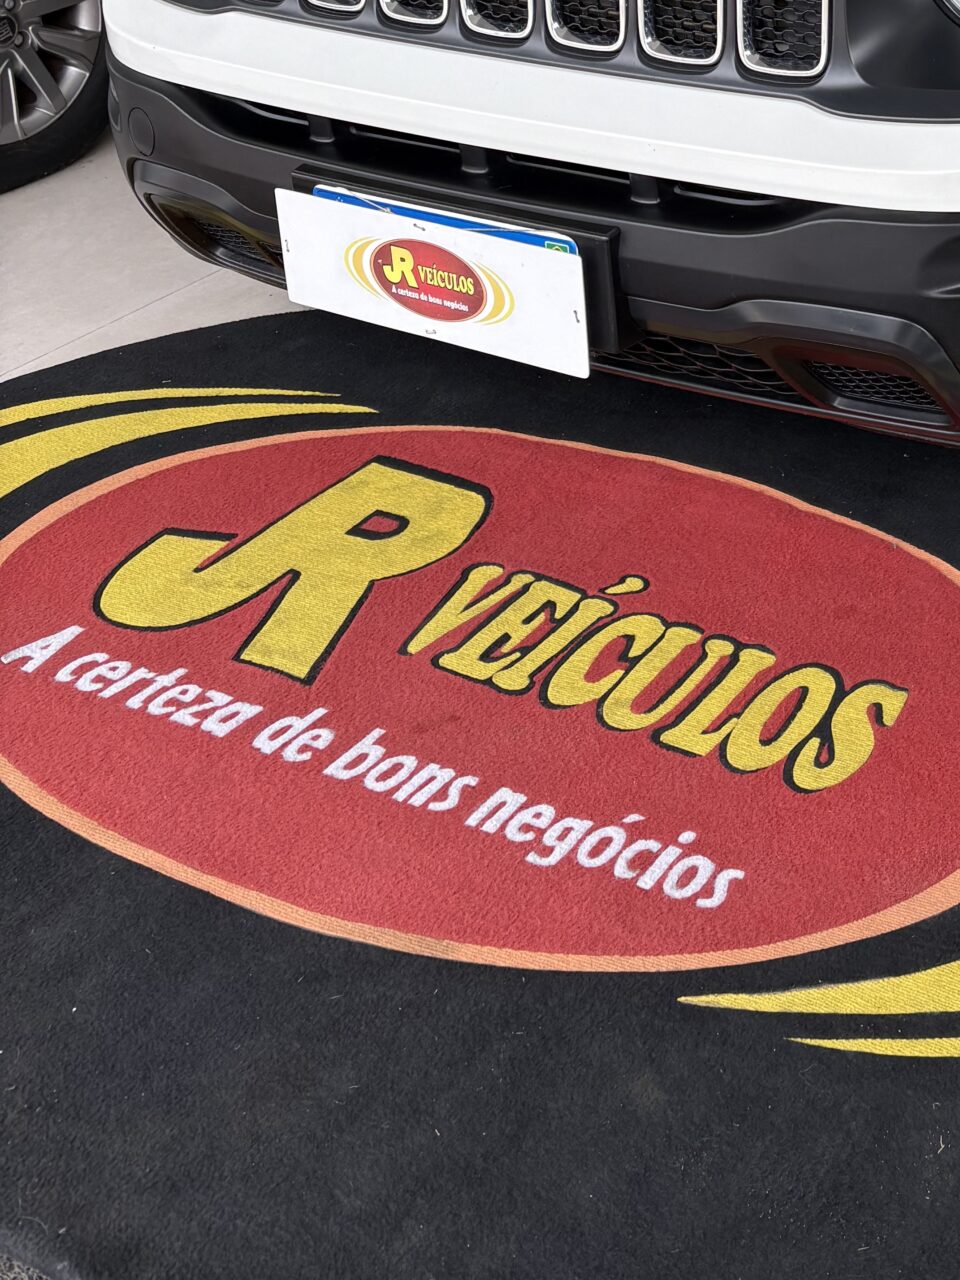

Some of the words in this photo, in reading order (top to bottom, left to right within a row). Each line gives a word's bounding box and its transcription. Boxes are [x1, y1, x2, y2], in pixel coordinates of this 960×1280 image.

[382, 244, 419, 289] JR
[417, 263, 475, 296] VEÍCULOS
[391, 284, 397, 294] A
[420, 292, 428, 302] de
[443, 300, 469, 312] negócios
[92, 456, 494, 685] JR
[405, 562, 908, 793] VEÍCULOS
[0, 625, 85, 673] A
[54, 652, 264, 738] certeza
[251, 707, 335, 762] de
[322, 727, 479, 812] bons
[464, 786, 746, 909] negócios
